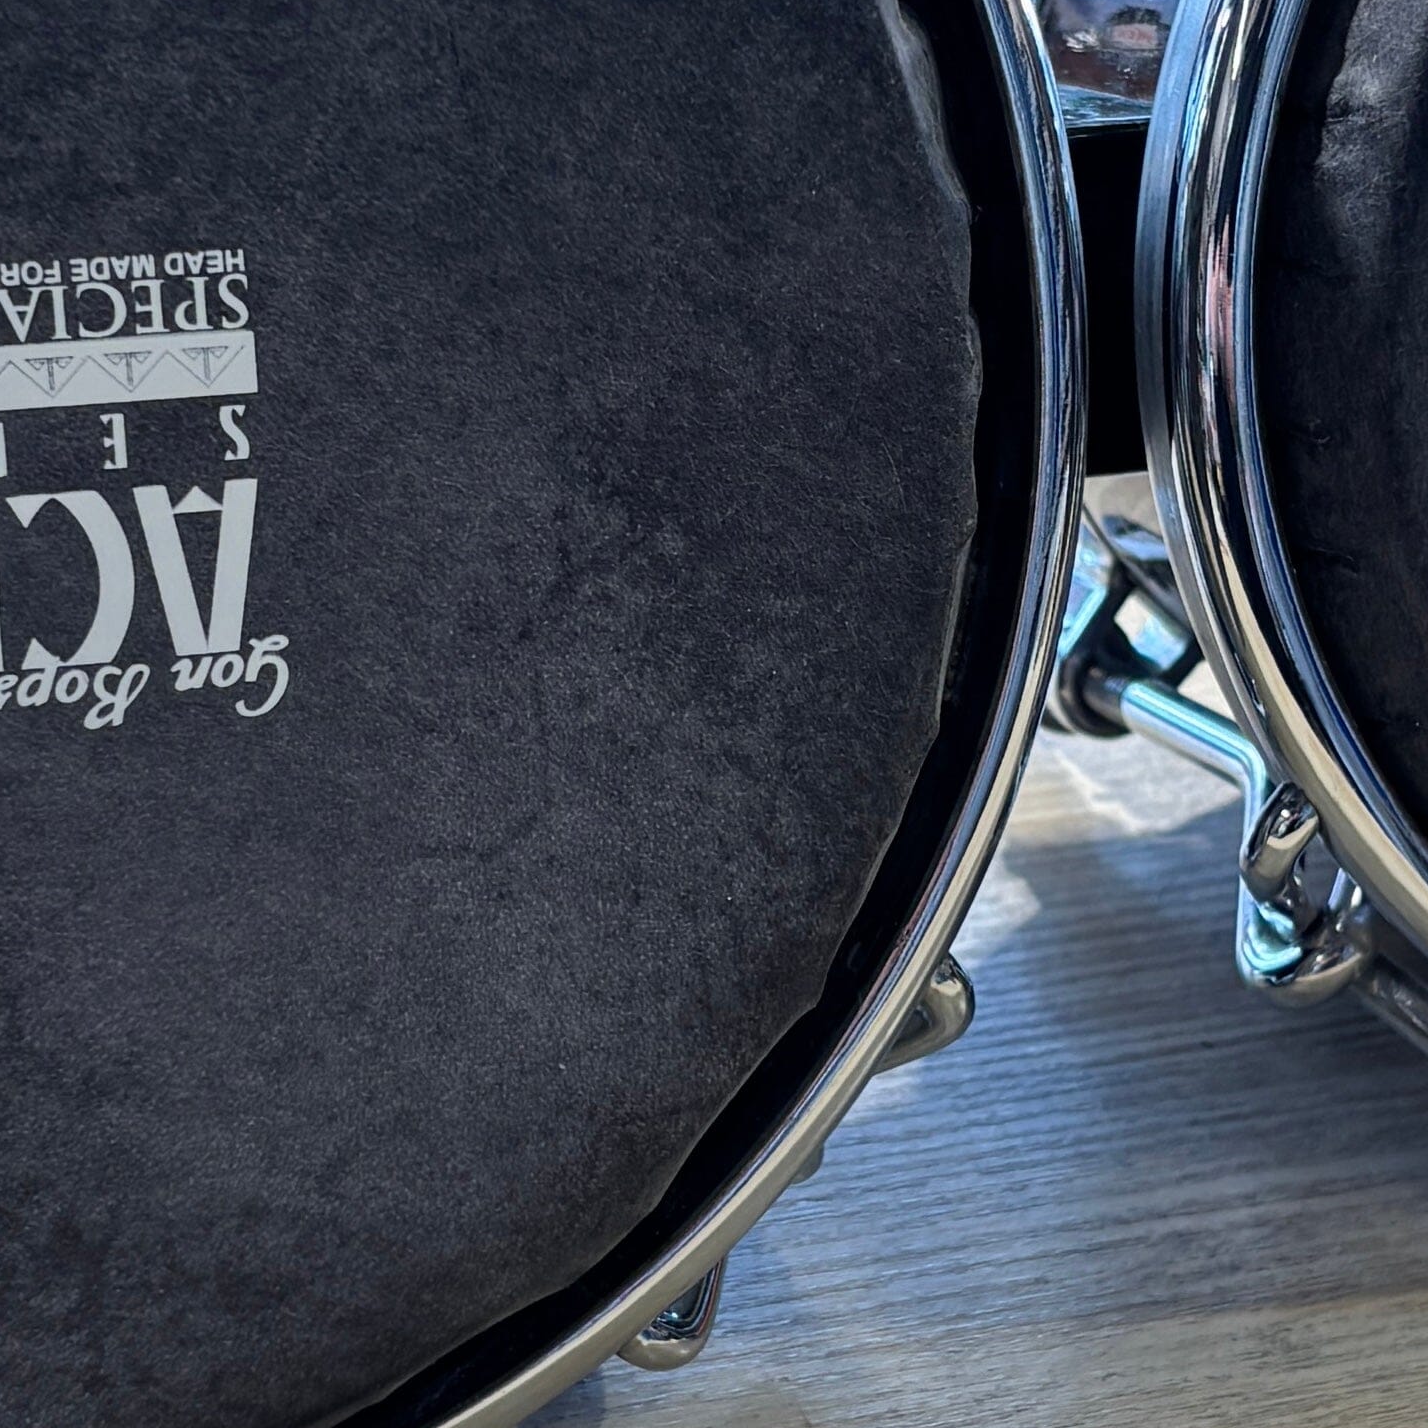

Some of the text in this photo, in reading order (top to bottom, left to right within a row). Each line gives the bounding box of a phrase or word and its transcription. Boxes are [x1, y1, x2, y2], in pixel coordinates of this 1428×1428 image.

[0, 260, 62, 287] FOR
[69, 255, 156, 282] MADE
[164, 249, 246, 276] HEAD
[170, 634, 290, 717] Gon
